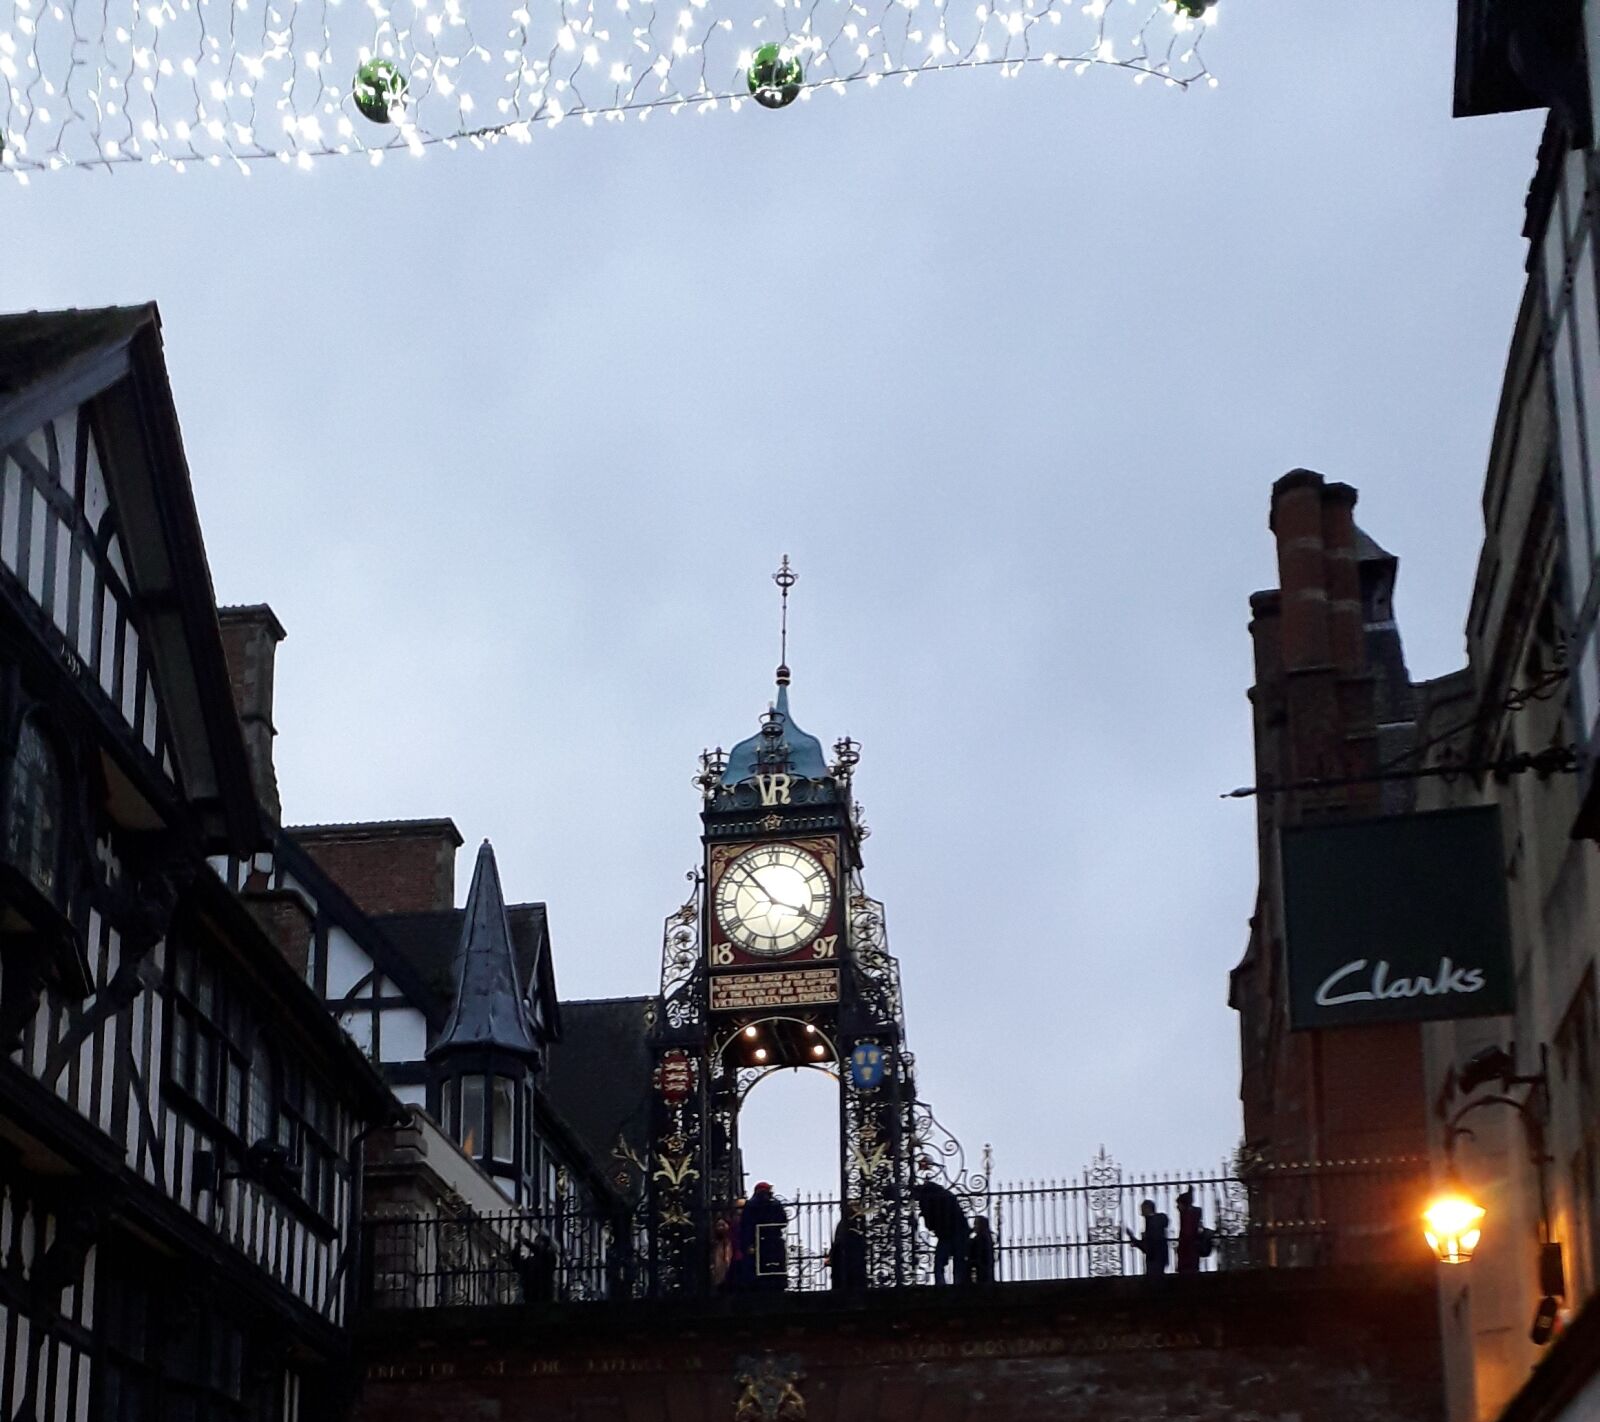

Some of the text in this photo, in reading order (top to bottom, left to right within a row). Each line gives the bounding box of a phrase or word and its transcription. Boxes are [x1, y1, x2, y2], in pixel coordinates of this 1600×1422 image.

[711, 943, 736, 966] 18
[812, 934, 840, 960] 97
[1314, 956, 1486, 1007] Clarks
